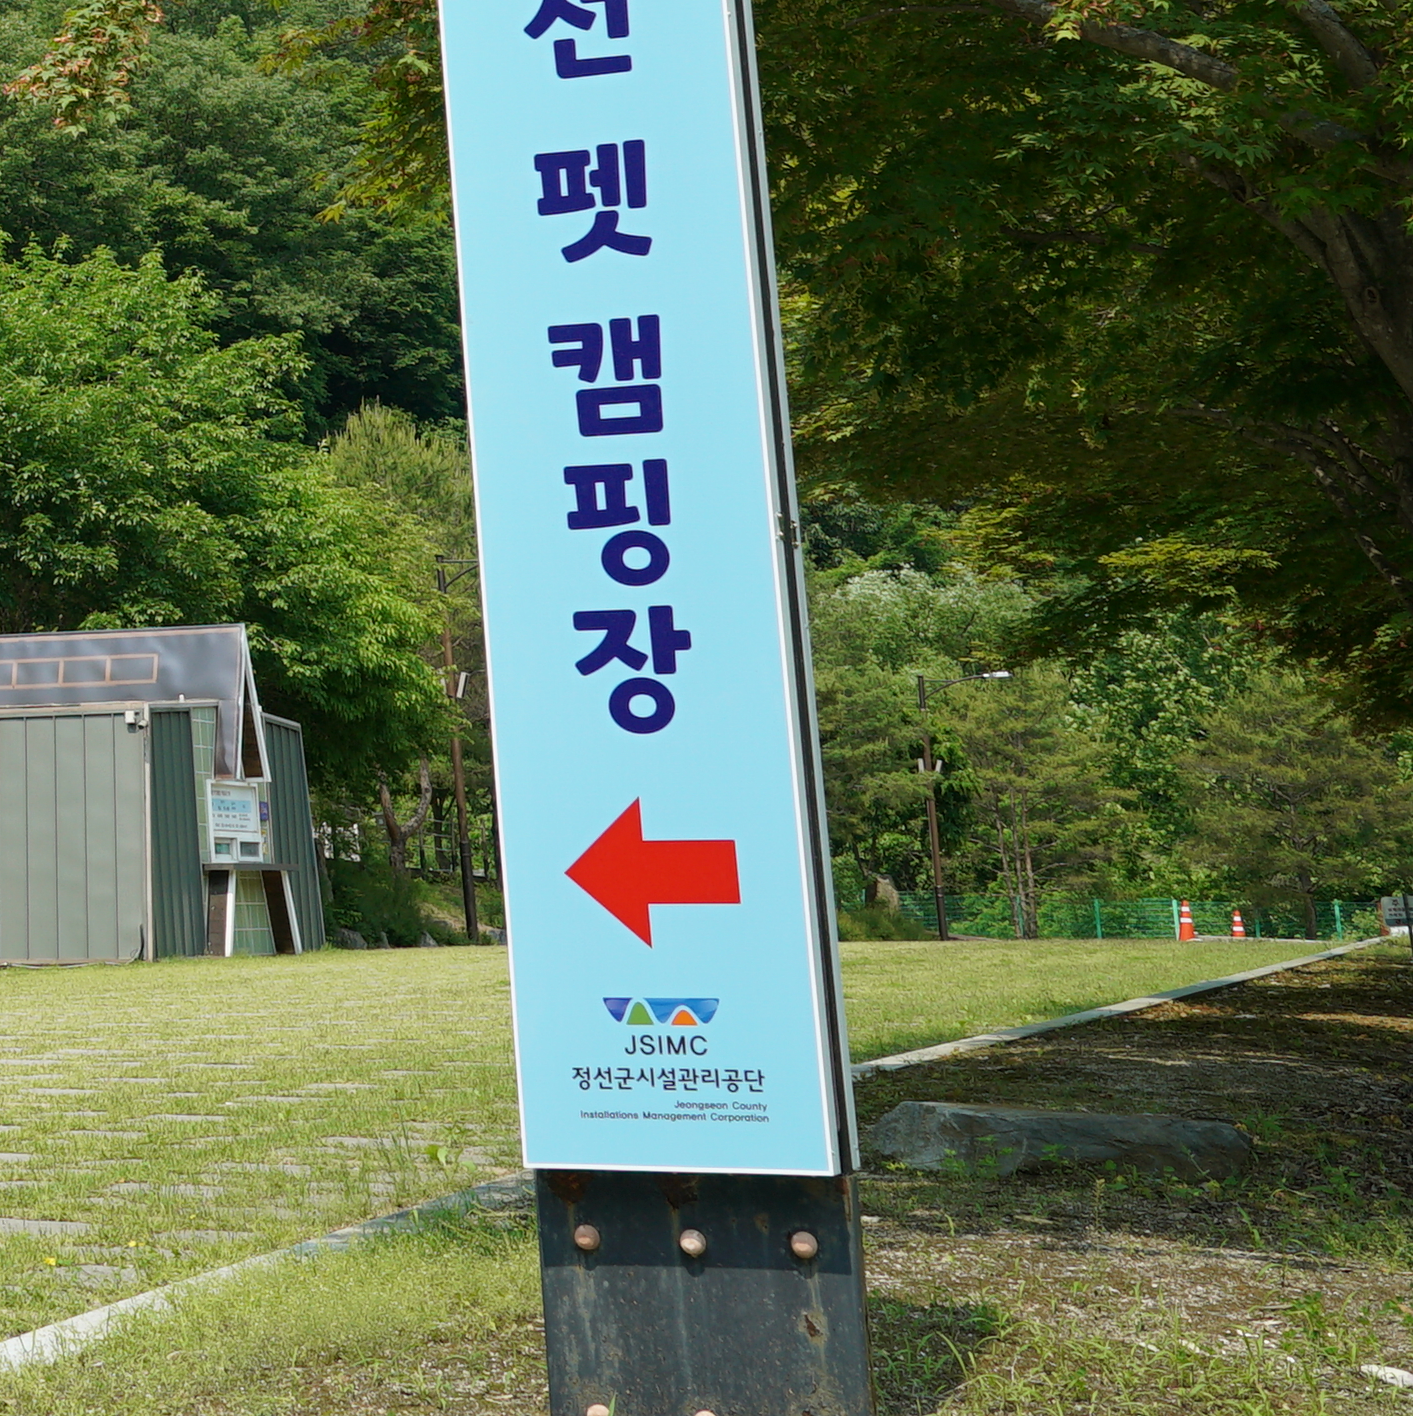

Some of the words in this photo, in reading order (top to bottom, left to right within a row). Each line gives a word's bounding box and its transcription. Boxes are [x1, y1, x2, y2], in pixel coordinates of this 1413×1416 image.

[533, 139, 653, 264] 펫
[547, 314, 692, 735] 캠핑장
[624, 1034, 708, 1056] JSIMC
[571, 1066, 765, 1093] 정선군시설관리공단
[580, 1110, 639, 1120] Installations
[642, 1111, 707, 1123] Management
[710, 1112, 770, 1124] Corporation
[674, 1100, 729, 1110] Jeongseon
[732, 1101, 768, 1113] County
